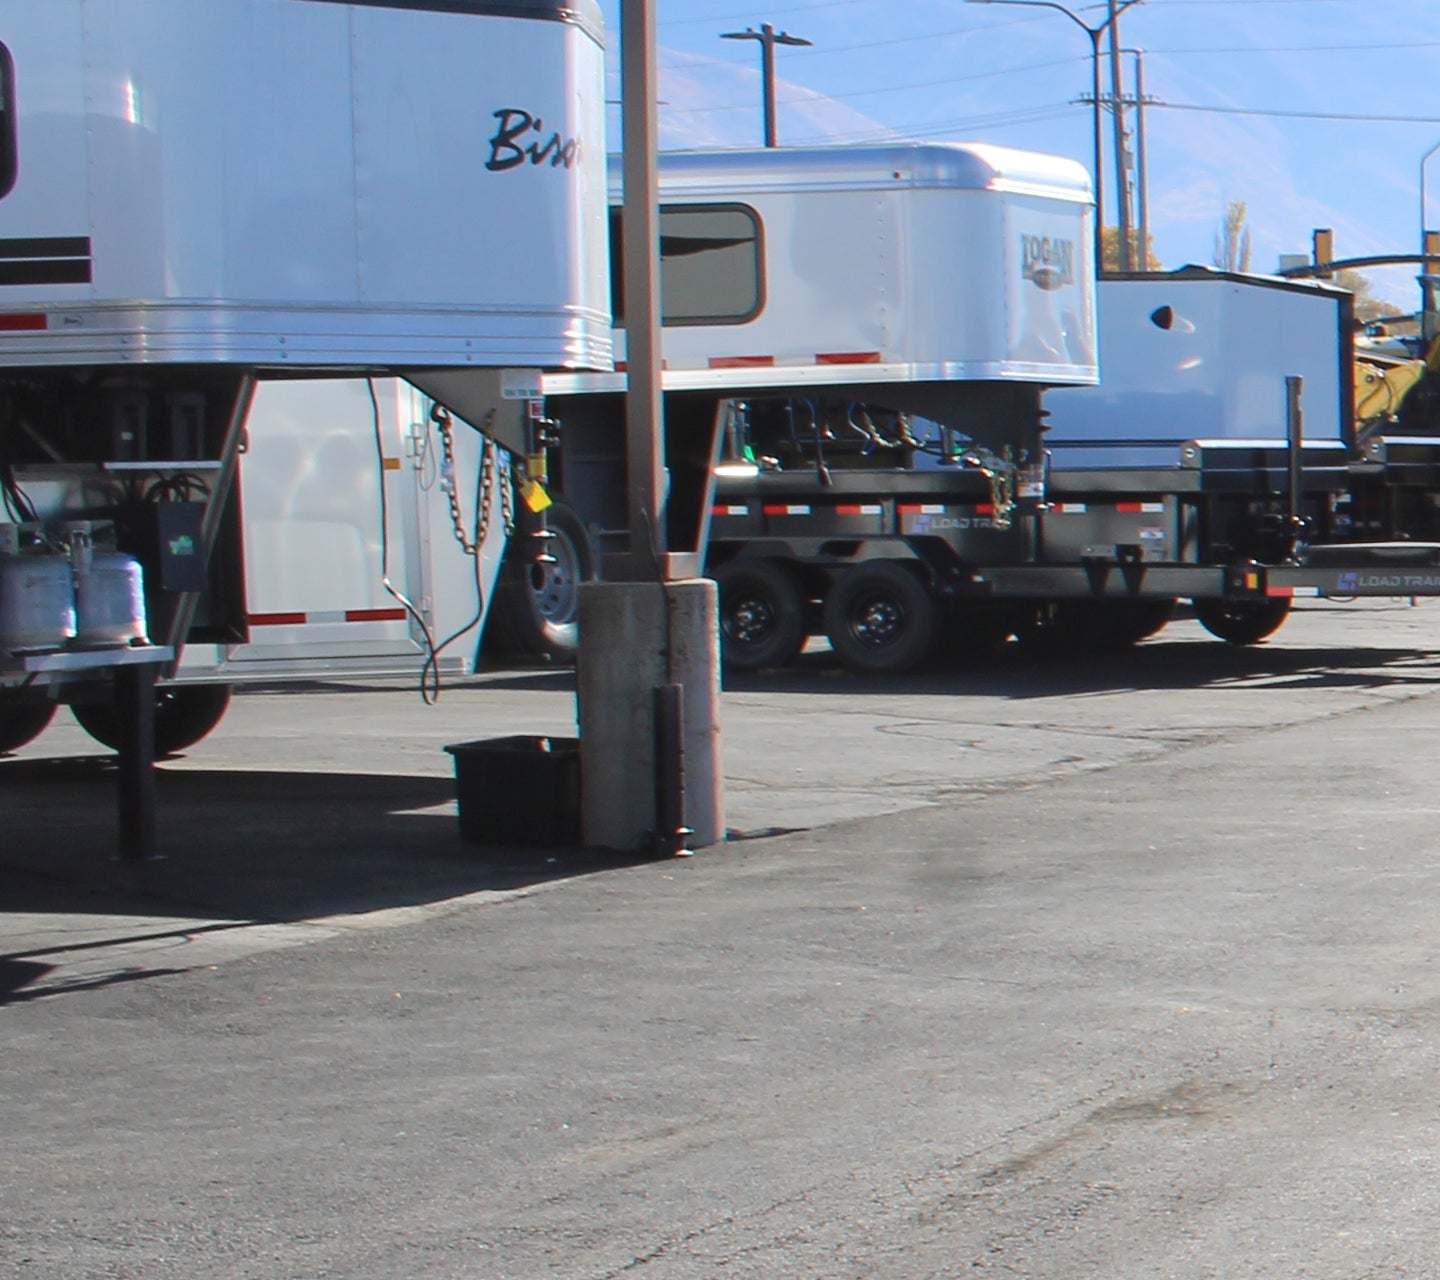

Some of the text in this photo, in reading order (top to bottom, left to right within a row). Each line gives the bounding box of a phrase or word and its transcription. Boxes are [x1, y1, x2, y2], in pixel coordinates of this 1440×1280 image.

[484, 107, 582, 172] Biso
[932, 518, 971, 529] LOAD
[1359, 576, 1401, 587] LOAD
